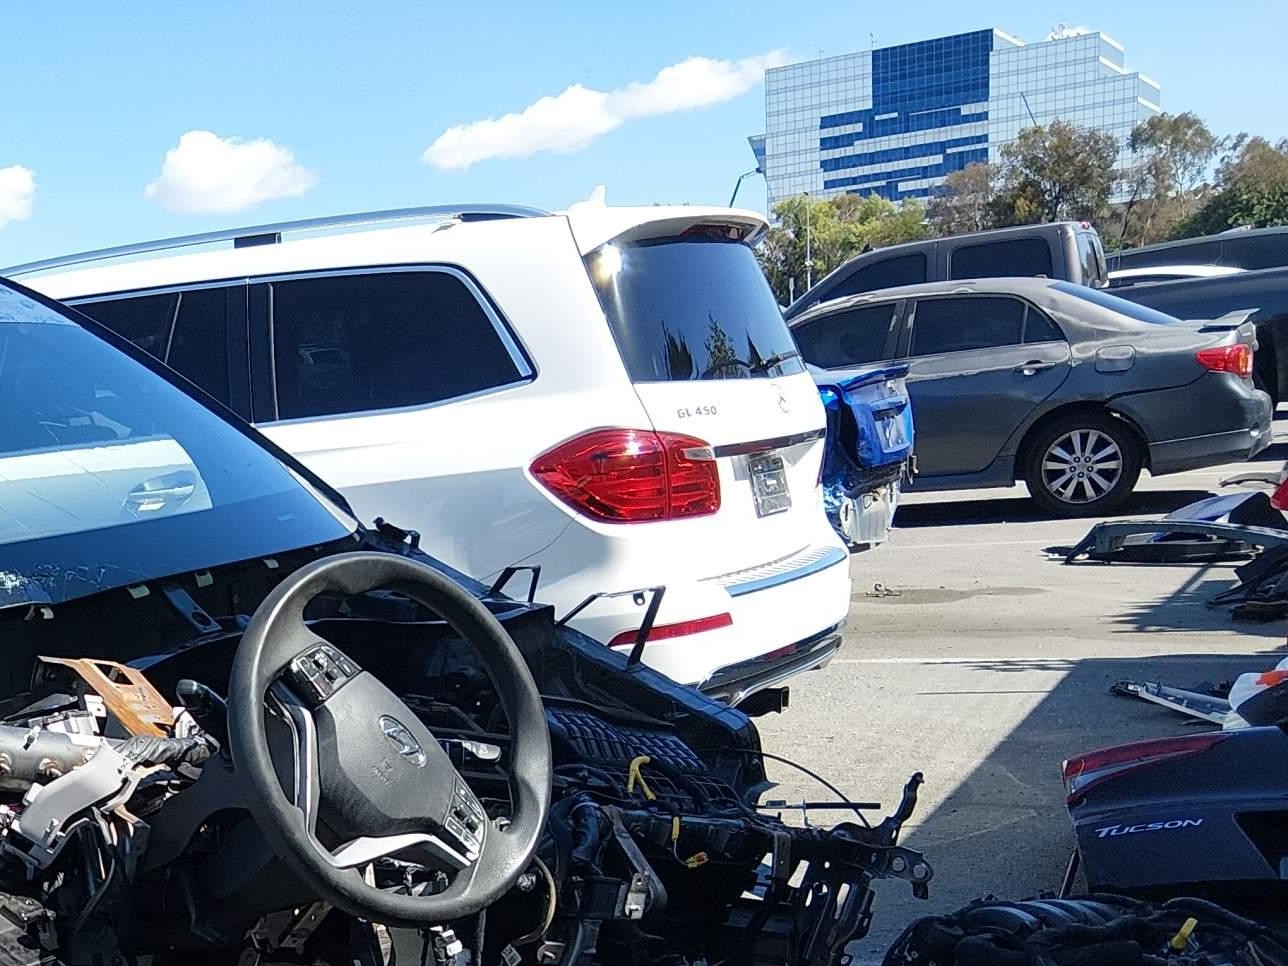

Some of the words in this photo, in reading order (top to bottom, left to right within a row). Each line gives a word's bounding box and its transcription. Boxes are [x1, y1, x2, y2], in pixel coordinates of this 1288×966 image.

[677, 407, 692, 419] GL
[695, 405, 717, 416] 450
[1095, 818, 1204, 839] TUCSON
